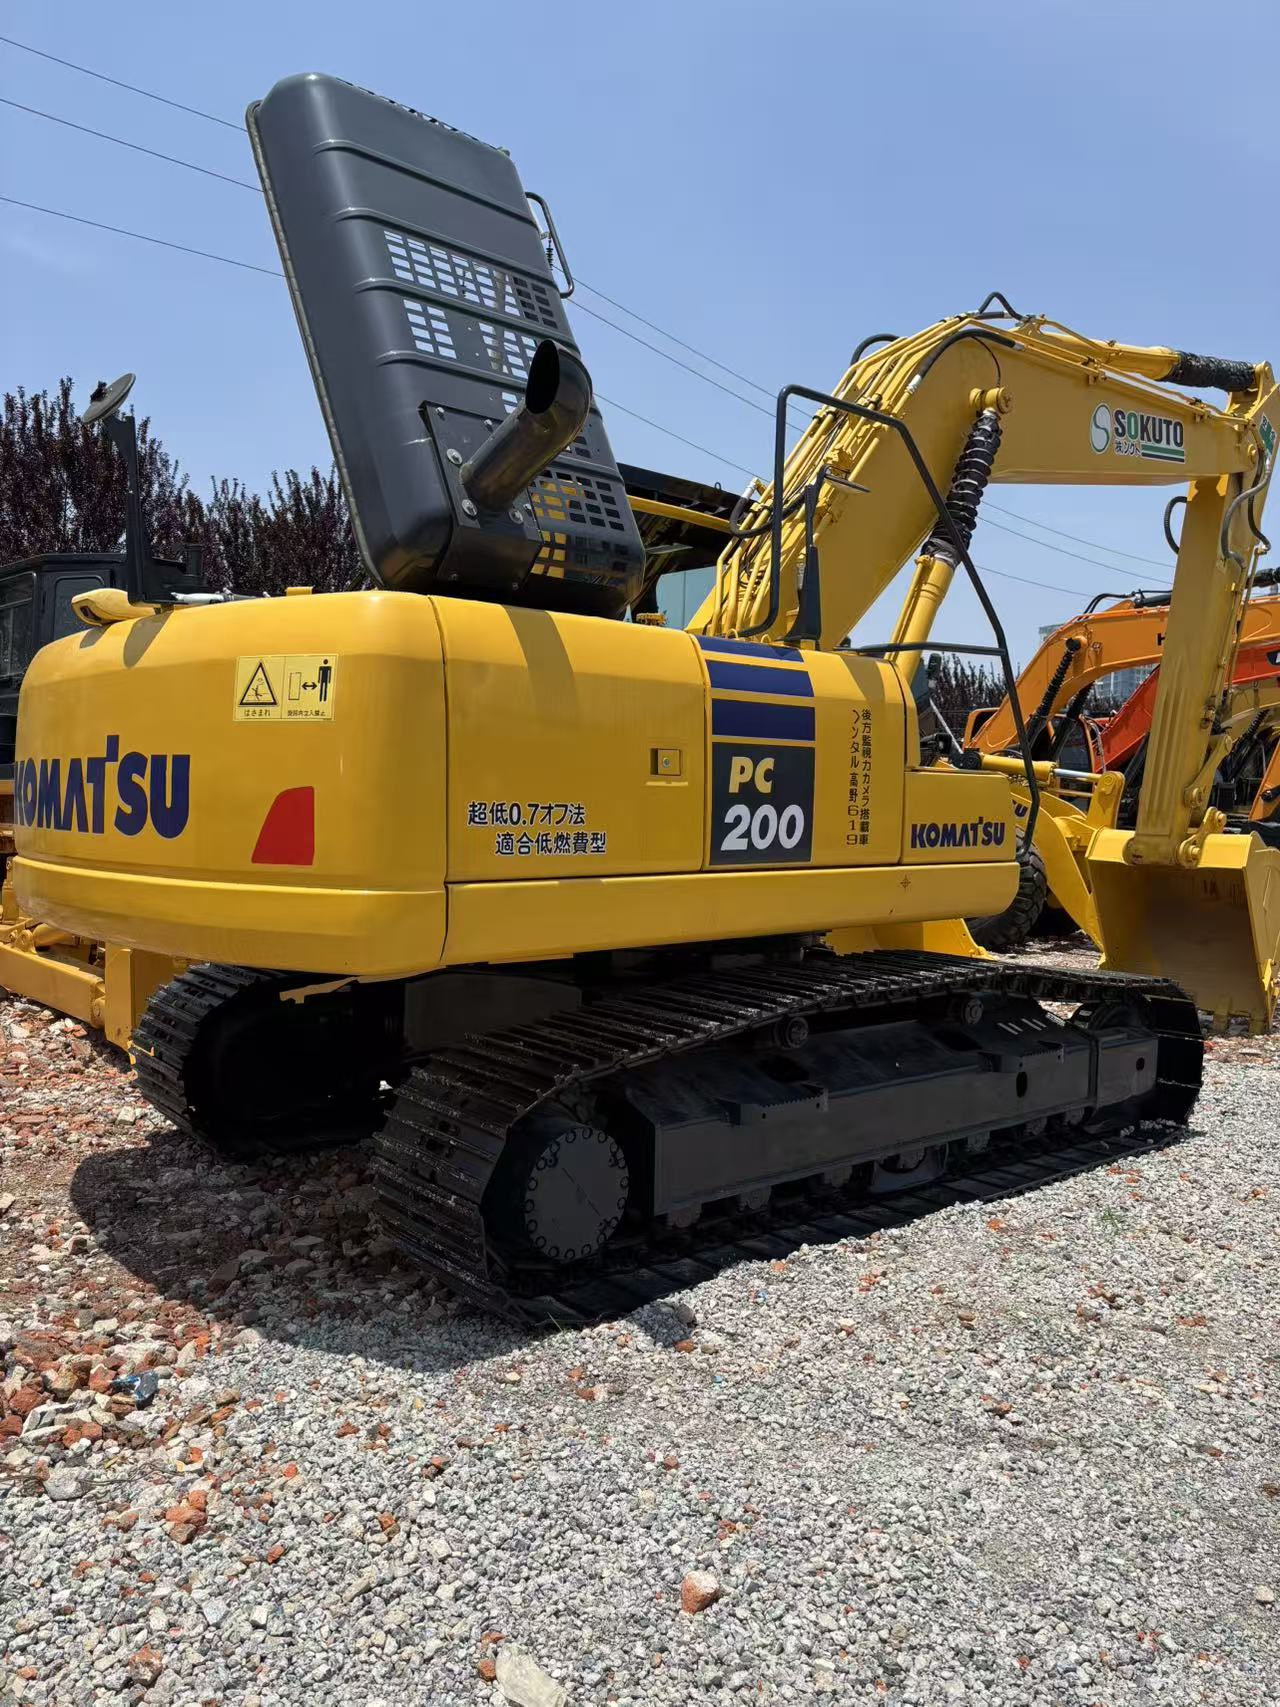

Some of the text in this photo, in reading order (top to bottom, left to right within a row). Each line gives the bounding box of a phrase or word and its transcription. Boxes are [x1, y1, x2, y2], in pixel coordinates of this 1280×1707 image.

[1114, 409, 1184, 448] SOKUTO
[15, 735, 191, 840] KOMATSU
[728, 756, 775, 794] PC
[495, 831, 606, 855] 適合低燃費型
[720, 804, 805, 851] 200
[911, 816, 1005, 849] KOMATSU
